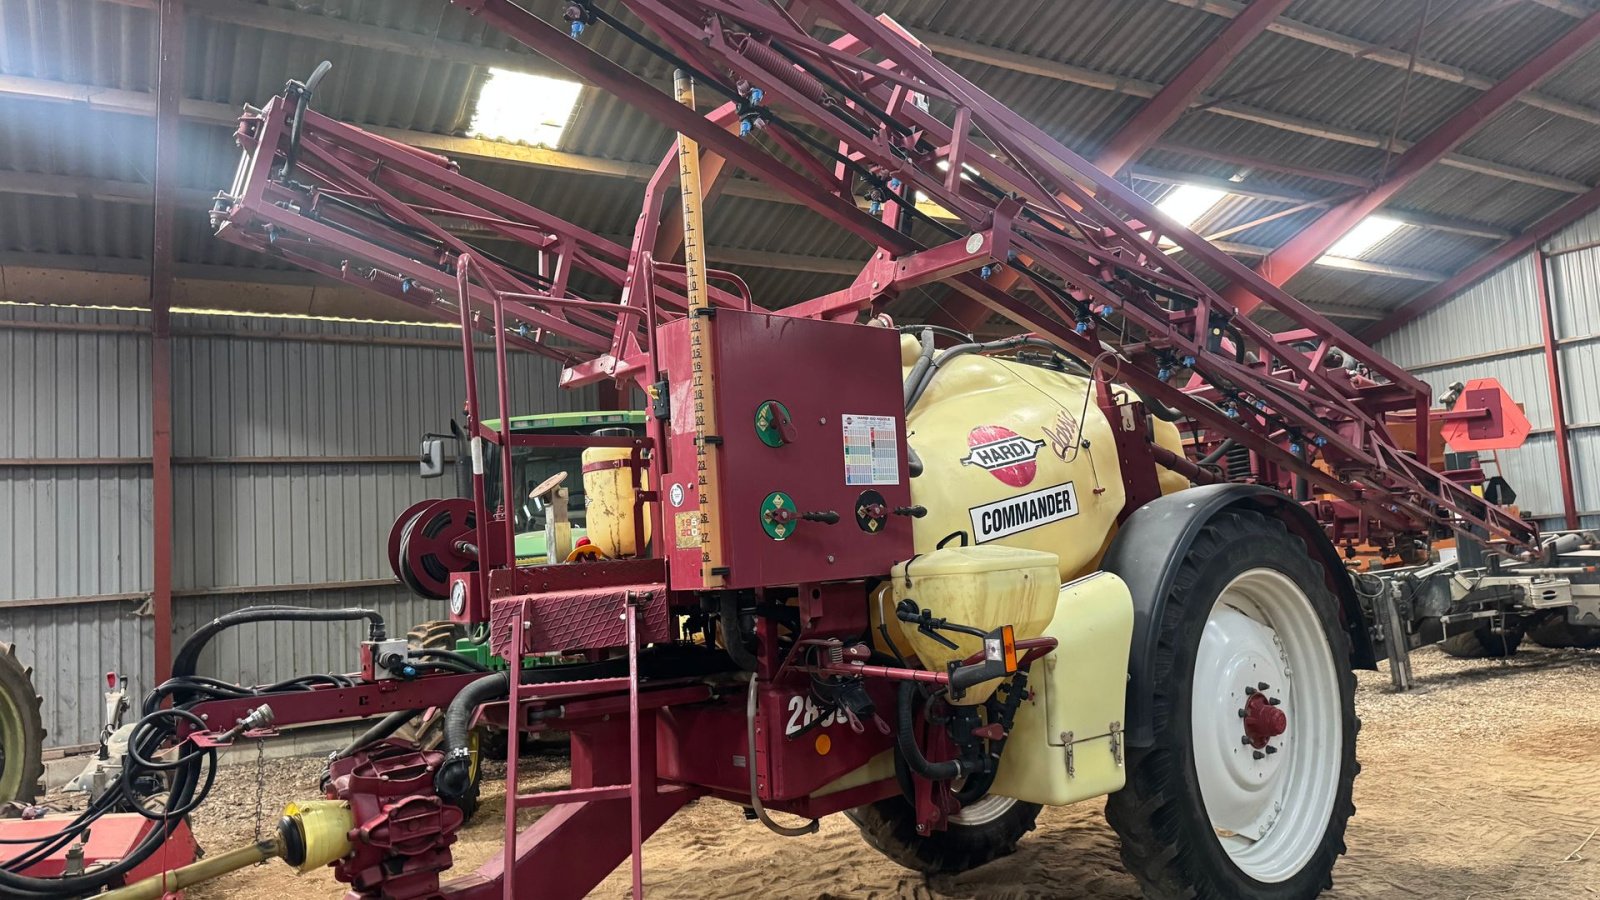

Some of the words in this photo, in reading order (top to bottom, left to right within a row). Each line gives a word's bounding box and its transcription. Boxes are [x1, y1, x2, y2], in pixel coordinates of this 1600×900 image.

[692, 348, 701, 357] 15
[693, 362, 702, 370] 16
[694, 376, 702, 384] 17
[695, 389, 703, 398] 18
[695, 403, 703, 411] 19
[696, 416, 704, 424] 20
[976, 440, 1031, 464] HARDI
[698, 461, 706, 469] 23
[698, 475, 706, 484] 24
[699, 494, 707, 502] 25
[981, 490, 1072, 535] COMMANDER
[700, 513, 708, 522] 26
[701, 533, 709, 542] 27
[702, 552, 710, 561] 28
